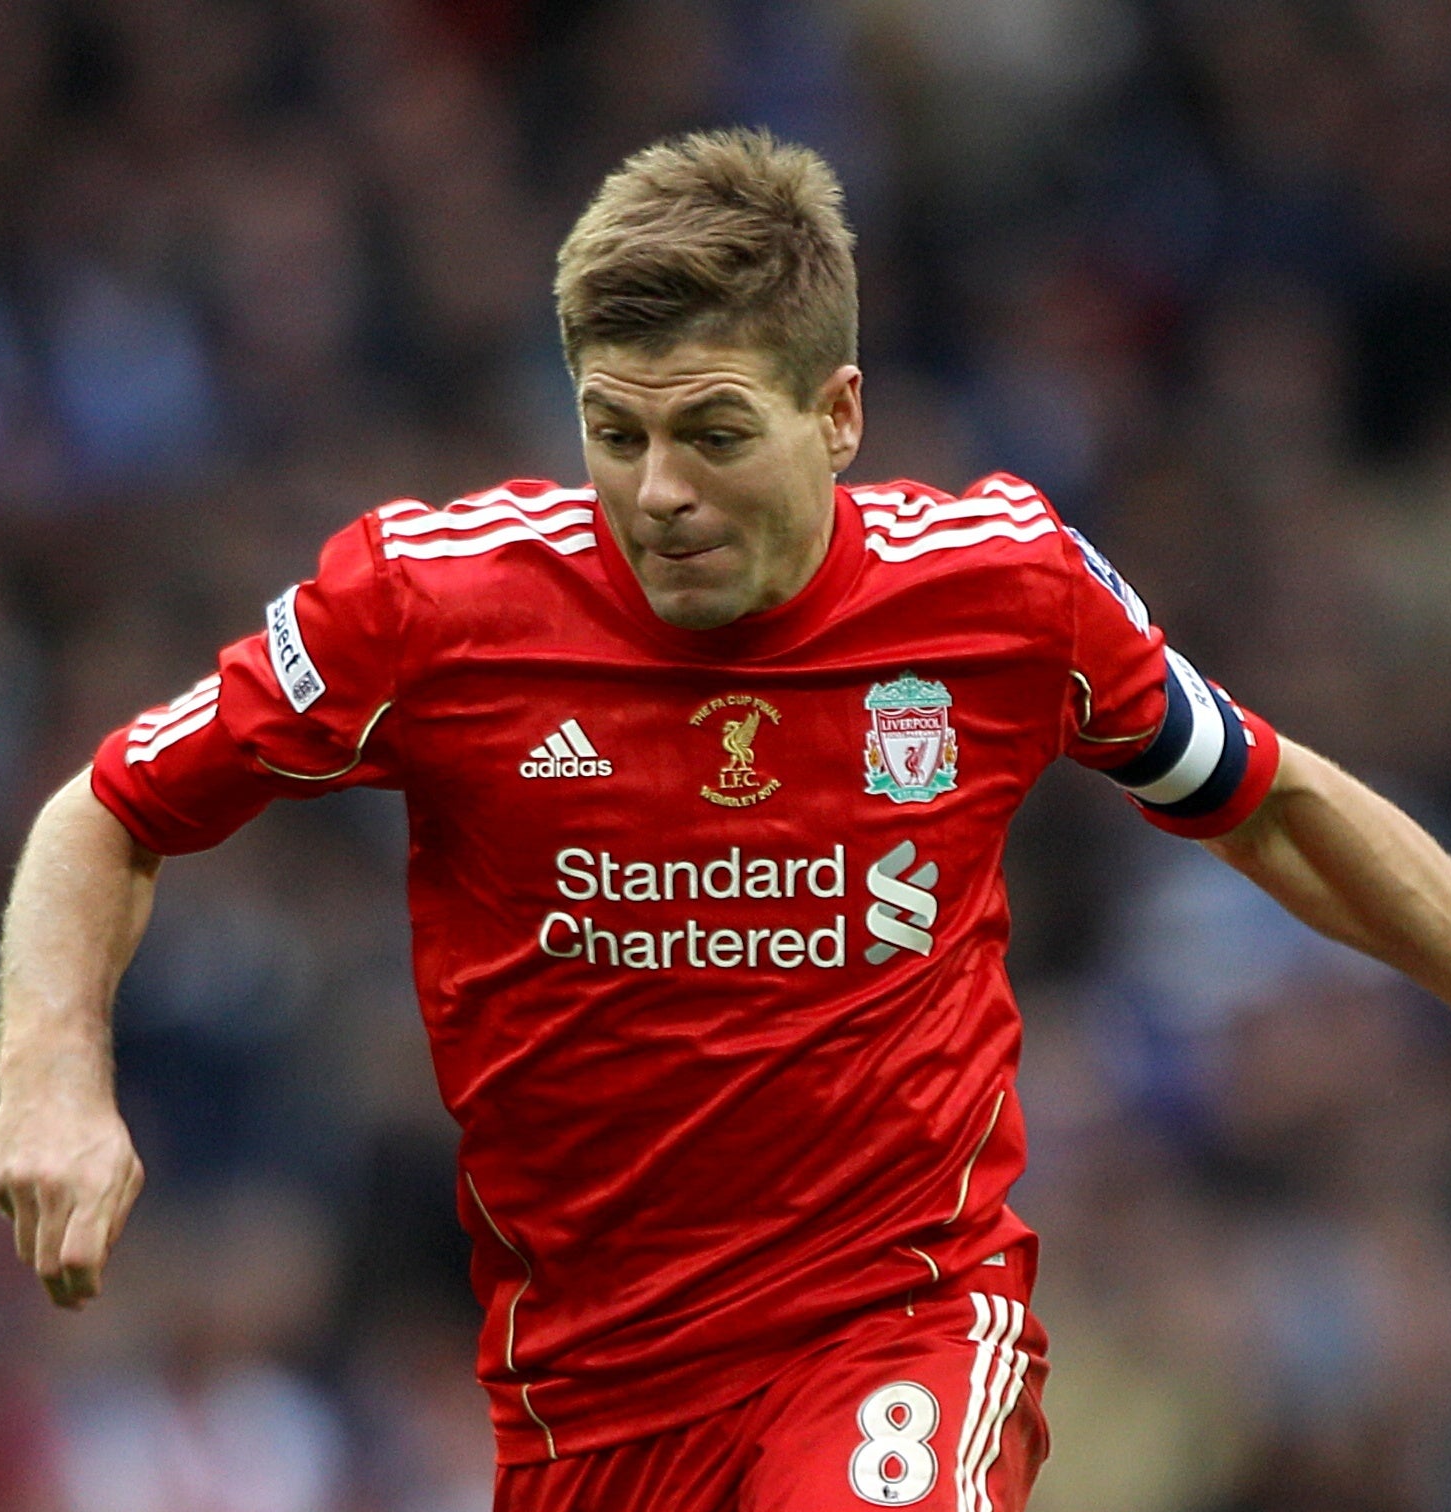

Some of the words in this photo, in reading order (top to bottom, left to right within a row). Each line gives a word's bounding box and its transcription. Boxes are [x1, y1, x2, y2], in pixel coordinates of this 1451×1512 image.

[273, 599, 302, 674] spect
[689, 706, 711, 726] THE
[727, 695, 752, 706] CUP
[882, 717, 941, 731] LIVERPOOL
[519, 756, 613, 778] adidas
[555, 844, 846, 902] Standard
[538, 911, 846, 970] Chartered
[848, 1380, 941, 1507] 8
